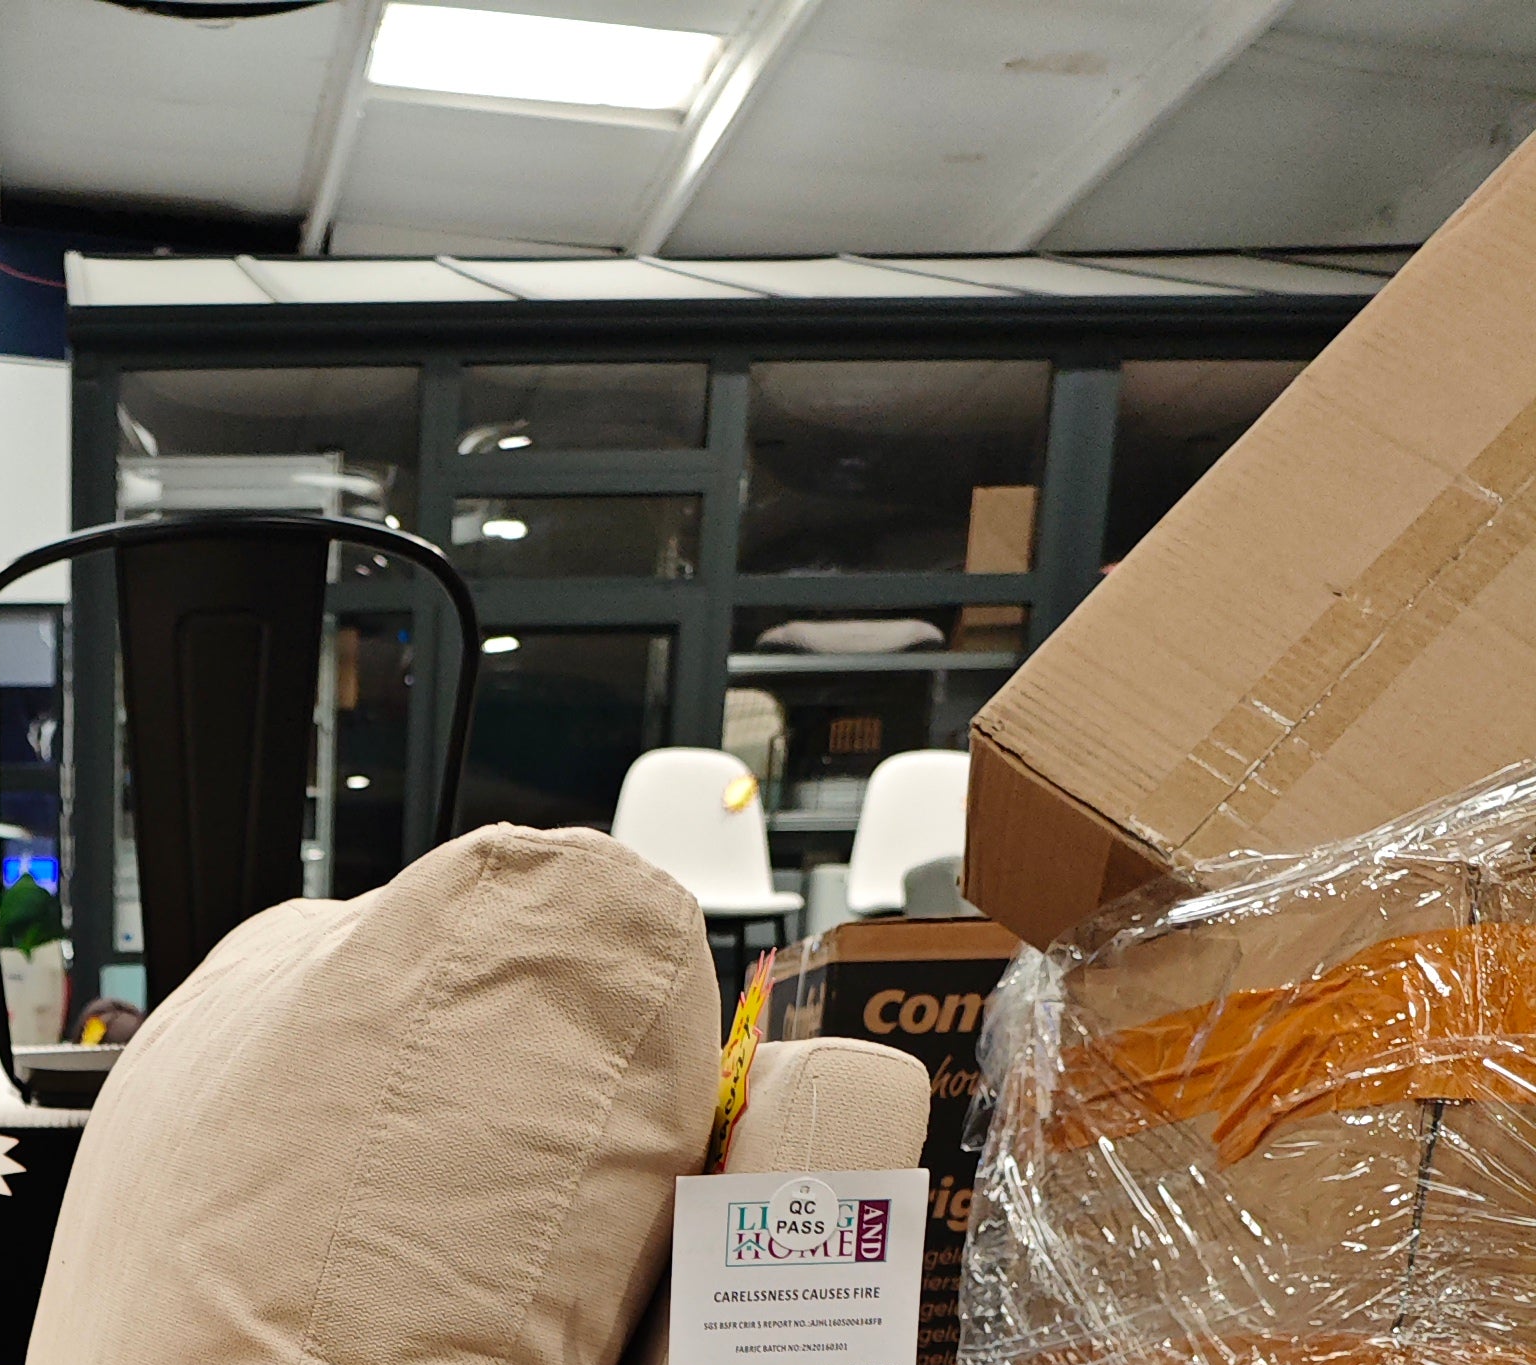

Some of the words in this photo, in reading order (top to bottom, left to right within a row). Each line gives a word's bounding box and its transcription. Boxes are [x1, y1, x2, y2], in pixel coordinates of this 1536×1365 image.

[789, 1200, 817, 1215] QC
[737, 1203, 855, 1231] LIG
[776, 1220, 825, 1235] PASS
[861, 1204, 885, 1260] AND
[802, 1287, 850, 1301] CAUSES
[853, 1286, 881, 1300] FIRE
[763, 1319, 792, 1329] REPORT
[763, 1344, 787, 1353] BATCH
